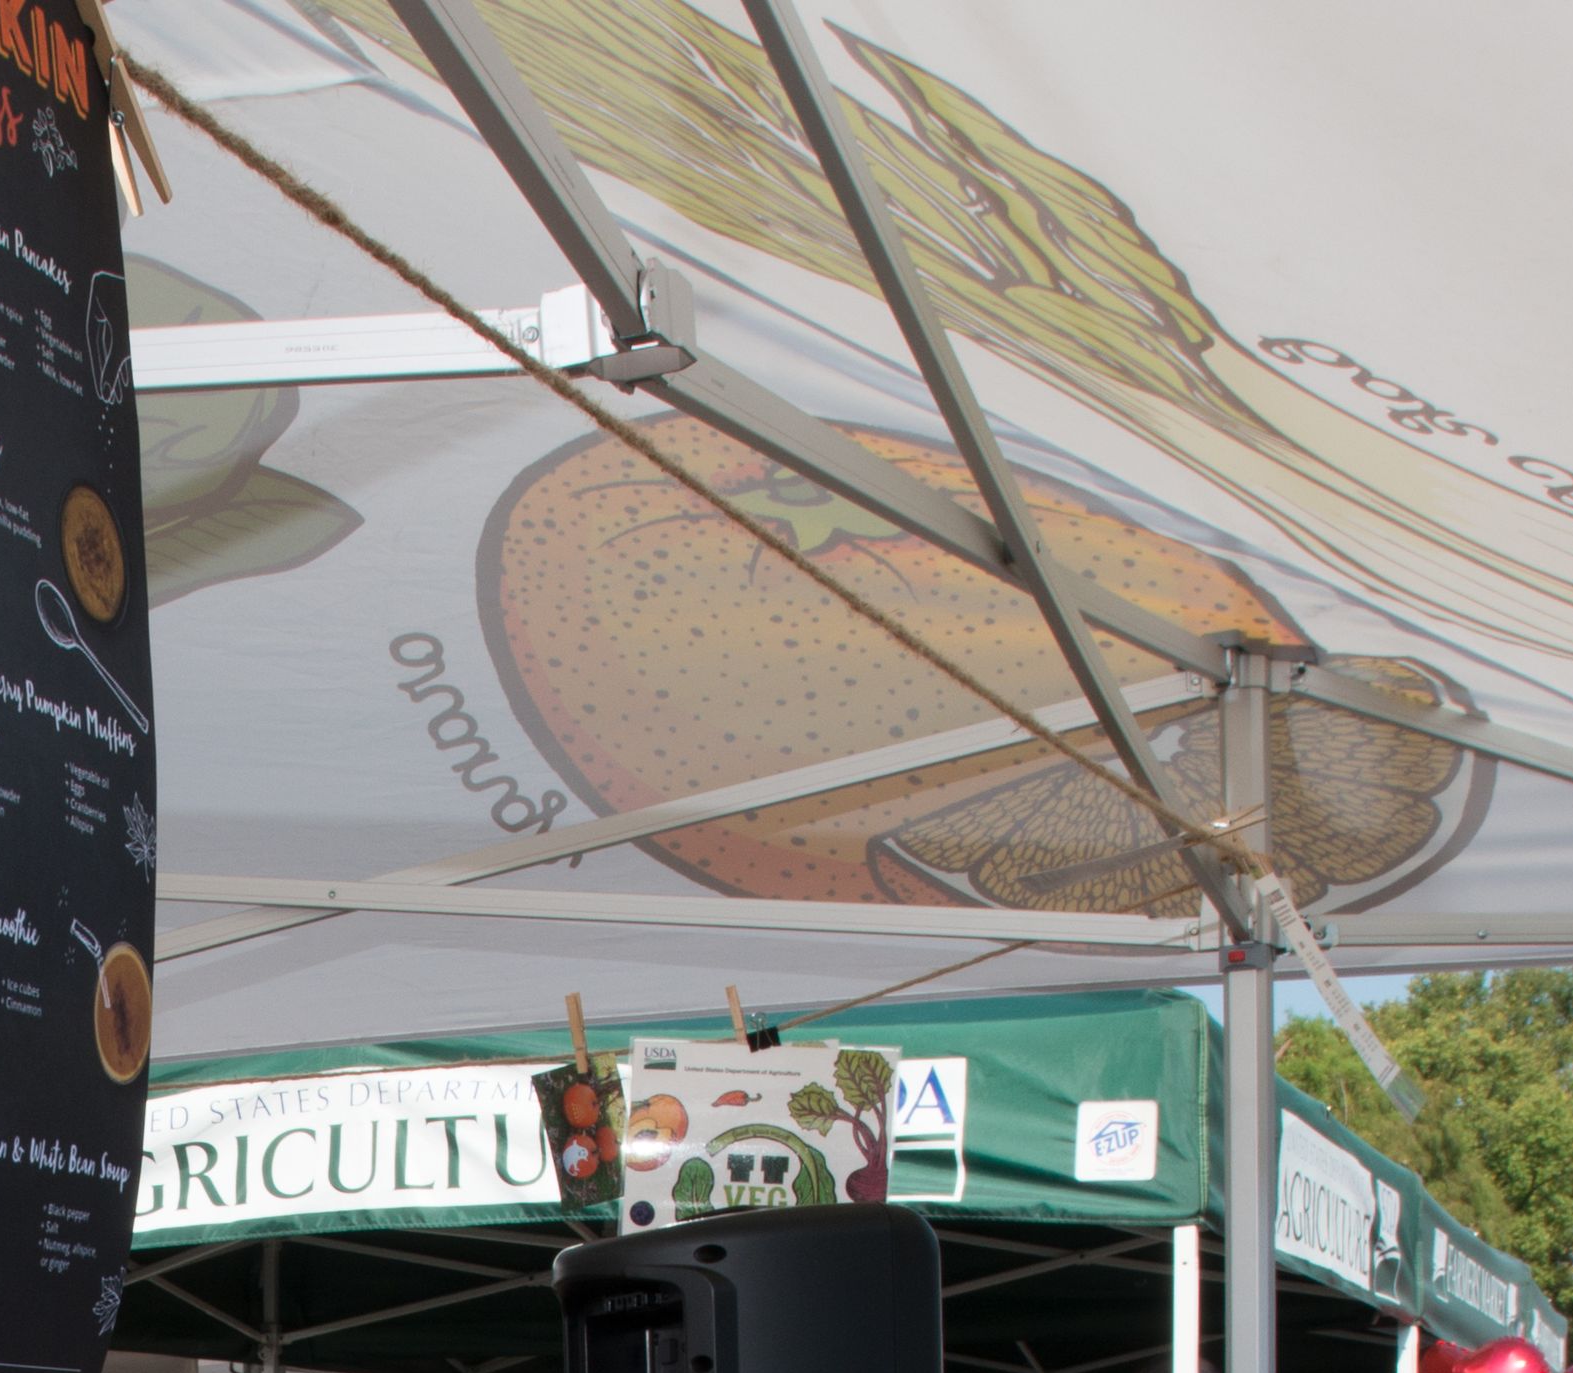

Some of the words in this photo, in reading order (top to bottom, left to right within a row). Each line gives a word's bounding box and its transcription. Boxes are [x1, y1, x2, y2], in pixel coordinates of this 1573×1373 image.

[14, 229, 72, 295] Pancakes
[25, 680, 82, 732] Pumpkin
[85, 706, 137, 757] Muffins
[6, 997, 42, 1017] Cinnamon
[7, 979, 18, 992] Ice
[19, 981, 40, 998] cubes
[643, 1047, 677, 1059] USDA
[725, 1067, 760, 1077] Department
[209, 1085, 330, 1126] STATES
[349, 1077, 539, 1108] DEPARTM
[12, 1136, 25, 1162] &
[29, 1137, 66, 1174] White
[68, 1144, 96, 1176] Bean
[100, 1151, 130, 1194] Soup
[134, 1113, 552, 1217] GRICULTU
[1277, 1171, 1371, 1276] AGRICULTURE
